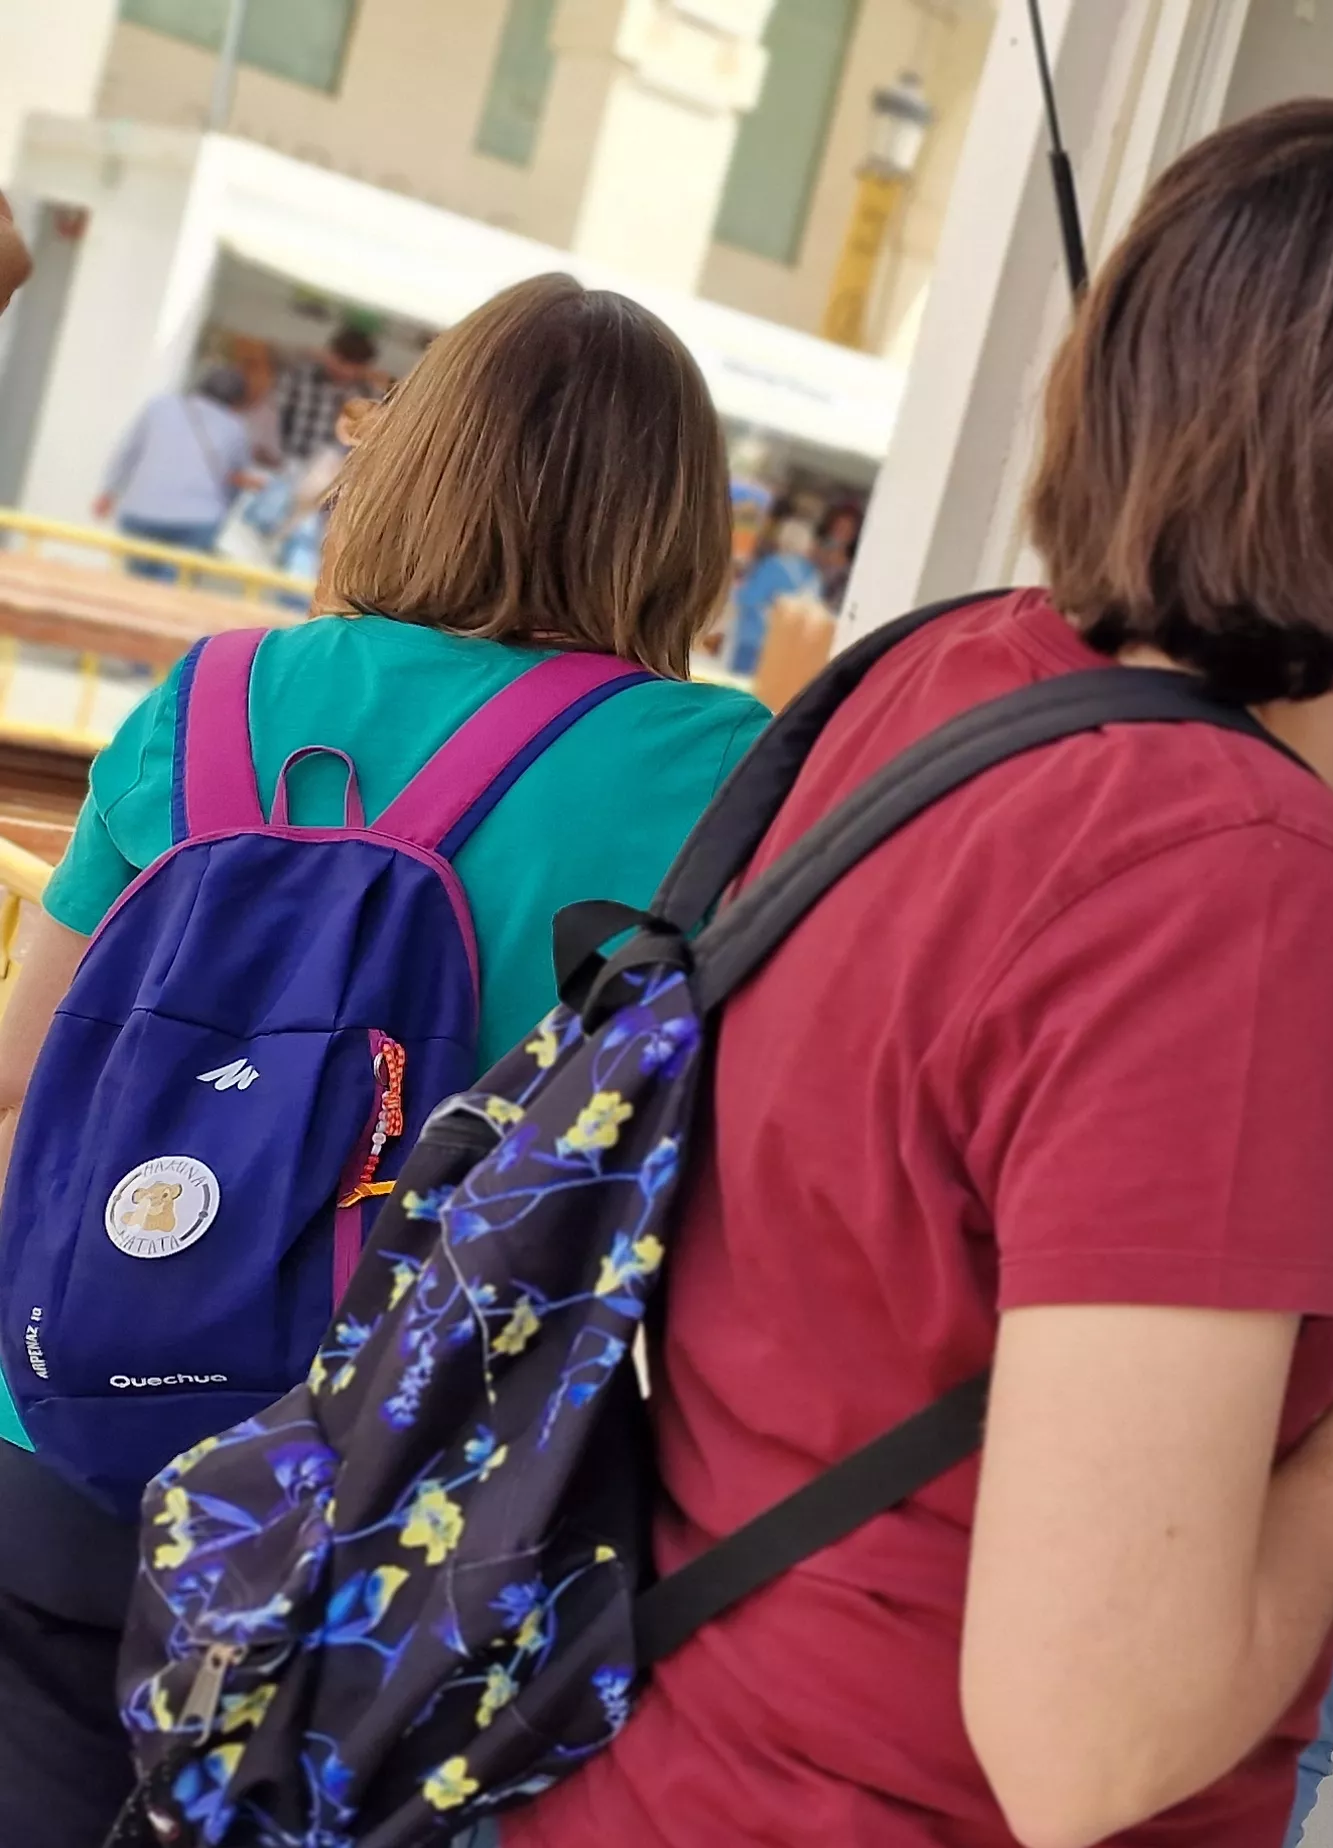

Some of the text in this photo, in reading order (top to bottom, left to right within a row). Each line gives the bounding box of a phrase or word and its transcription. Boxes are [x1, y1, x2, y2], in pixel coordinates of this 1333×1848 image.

[143, 1160, 207, 1187] HAKUNA
[24, 1324, 49, 1379] ARPENAZ
[109, 1373, 228, 1388] Quechua
